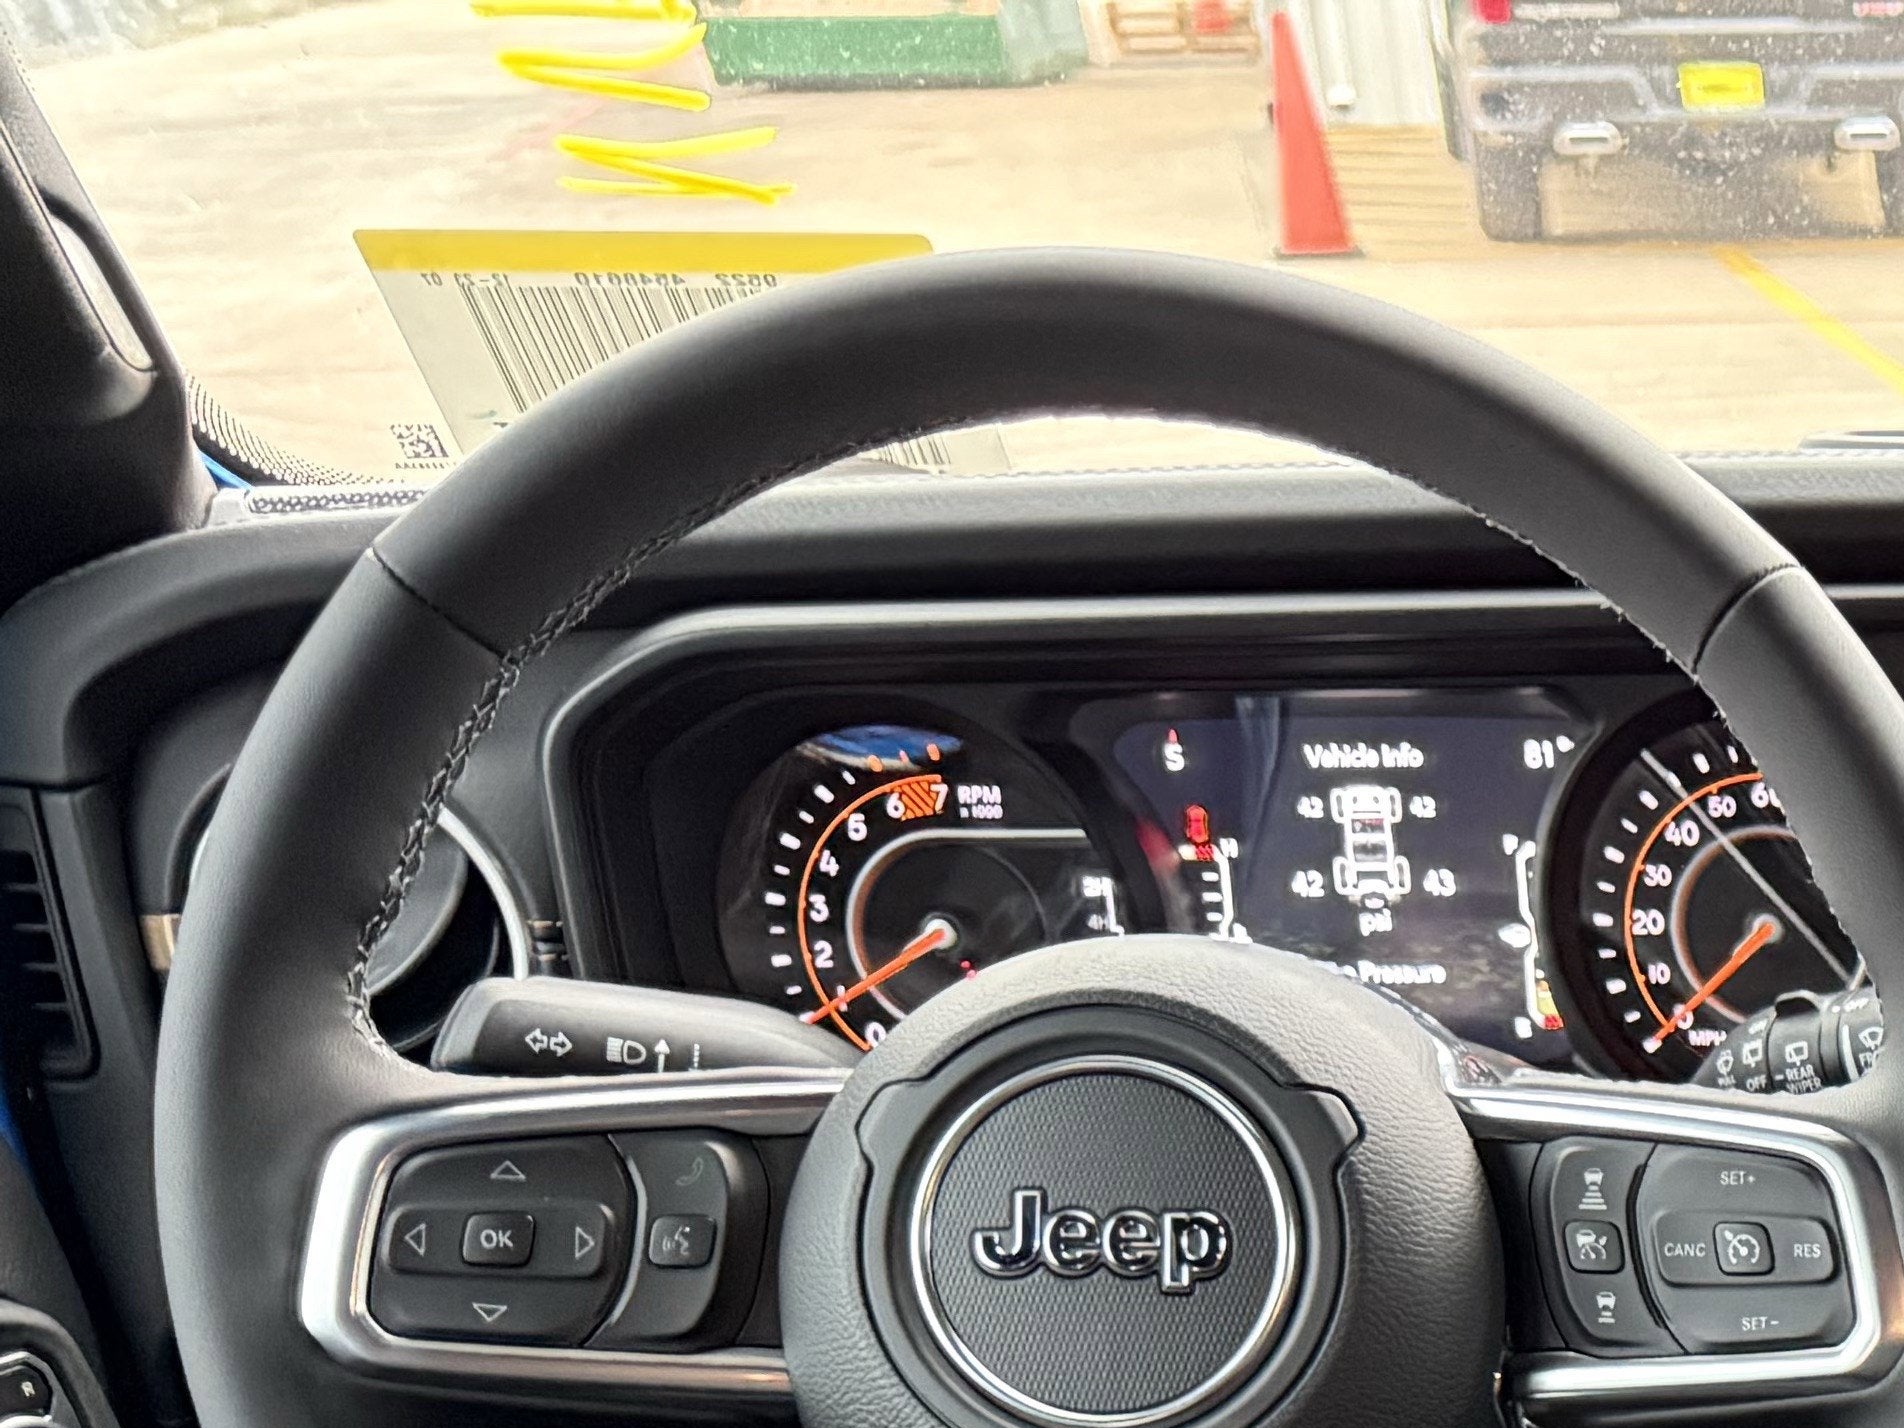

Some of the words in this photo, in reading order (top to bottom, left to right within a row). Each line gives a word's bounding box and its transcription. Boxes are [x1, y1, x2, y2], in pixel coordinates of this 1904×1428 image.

[1164, 742, 1185, 772] S
[1303, 744, 1379, 769] Vehicle
[1381, 743, 1424, 769] Info
[886, 792, 905, 818] 6
[931, 784, 949, 814] 7
[957, 786, 1001, 804] RPM
[1297, 797, 1323, 819] 42
[1409, 796, 1436, 818] 42
[1708, 795, 1737, 818] 50
[848, 813, 867, 841] 5
[1665, 820, 1700, 847] 40
[819, 850, 839, 877] 4
[1643, 864, 1673, 887] 30
[1291, 871, 1325, 898] 42
[1424, 869, 1456, 897] 43
[809, 894, 829, 922] 3
[1631, 909, 1665, 936] 20
[814, 941, 834, 968] 2
[1648, 963, 1671, 985] 10
[1746, 1074, 1767, 1091] OFF
[480, 1229, 513, 1249] OK
[970, 1187, 1233, 1294] Jeep
[1664, 1243, 1706, 1257] CANC
[1793, 1244, 1821, 1258] RES
